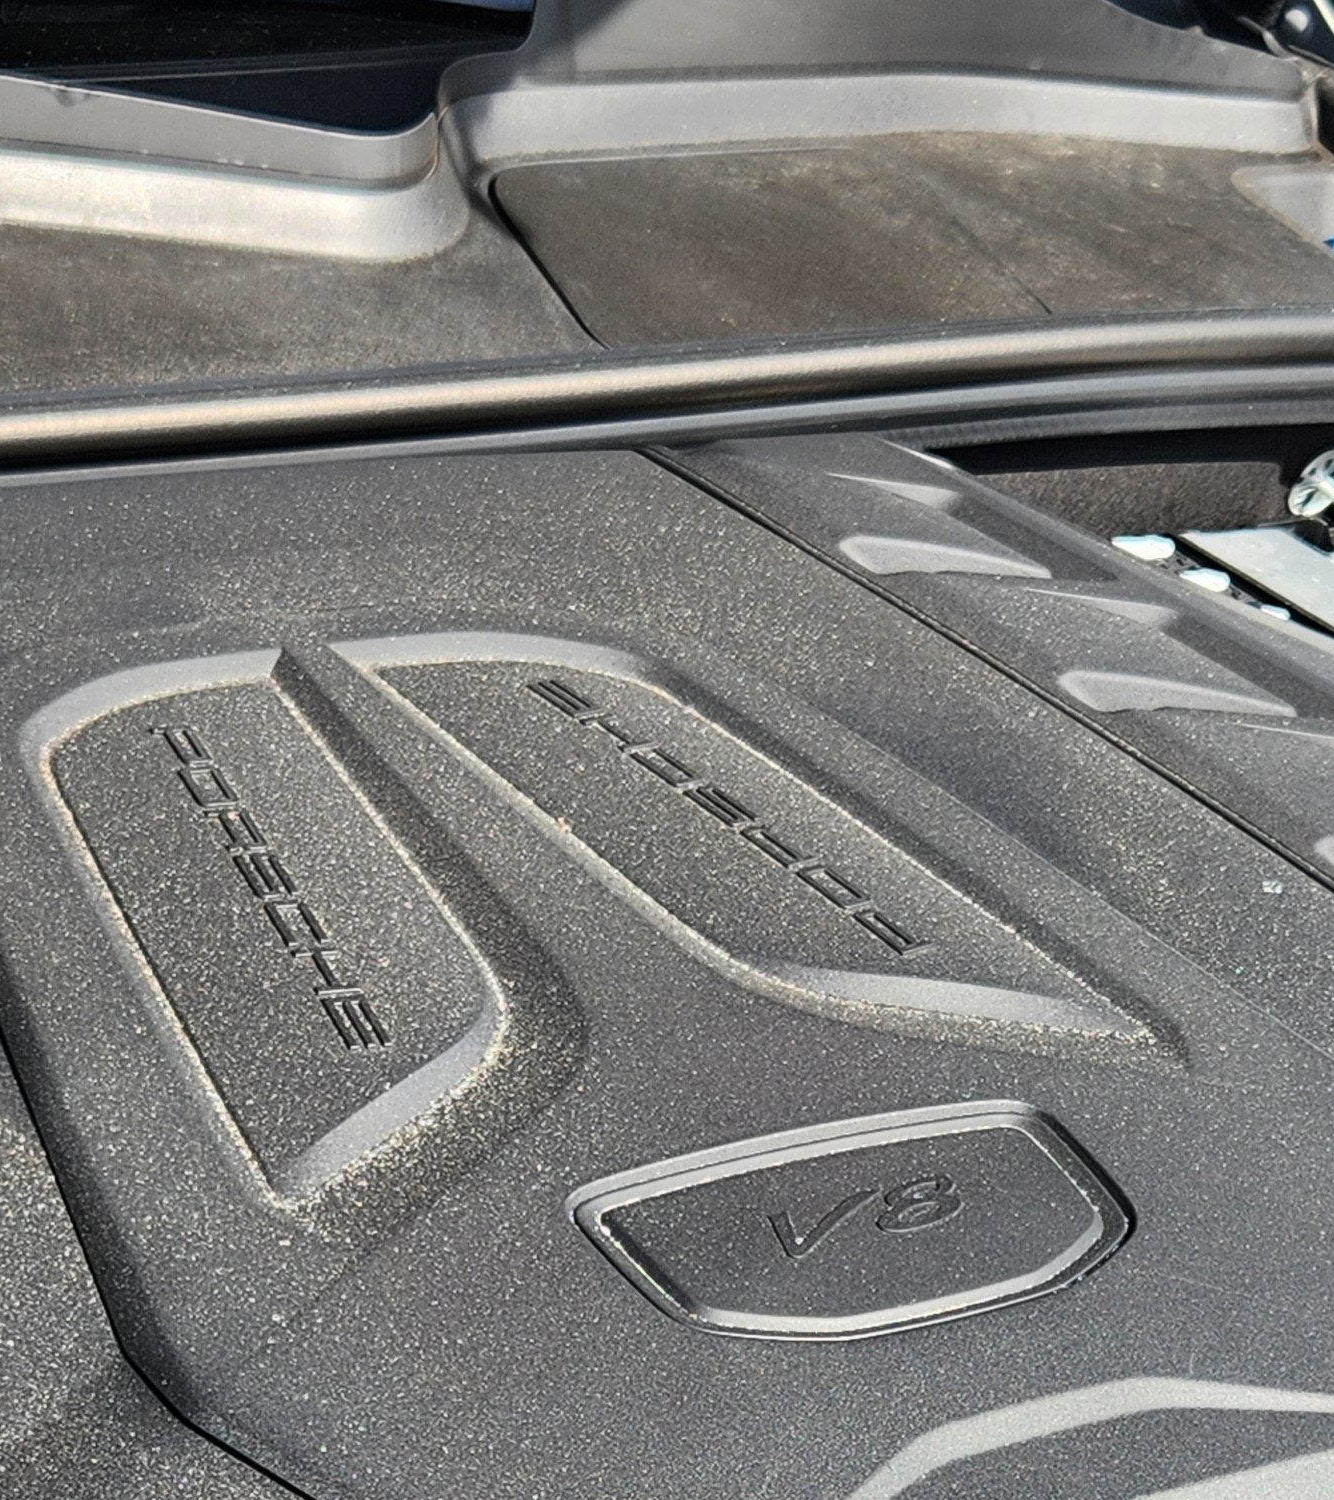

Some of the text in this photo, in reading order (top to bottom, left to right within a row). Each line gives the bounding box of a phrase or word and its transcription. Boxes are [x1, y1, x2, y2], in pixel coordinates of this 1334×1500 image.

[148, 727, 392, 1050] PORSCHE
[526, 679, 937, 957] PORSCHE
[766, 1173, 965, 1259] V8
